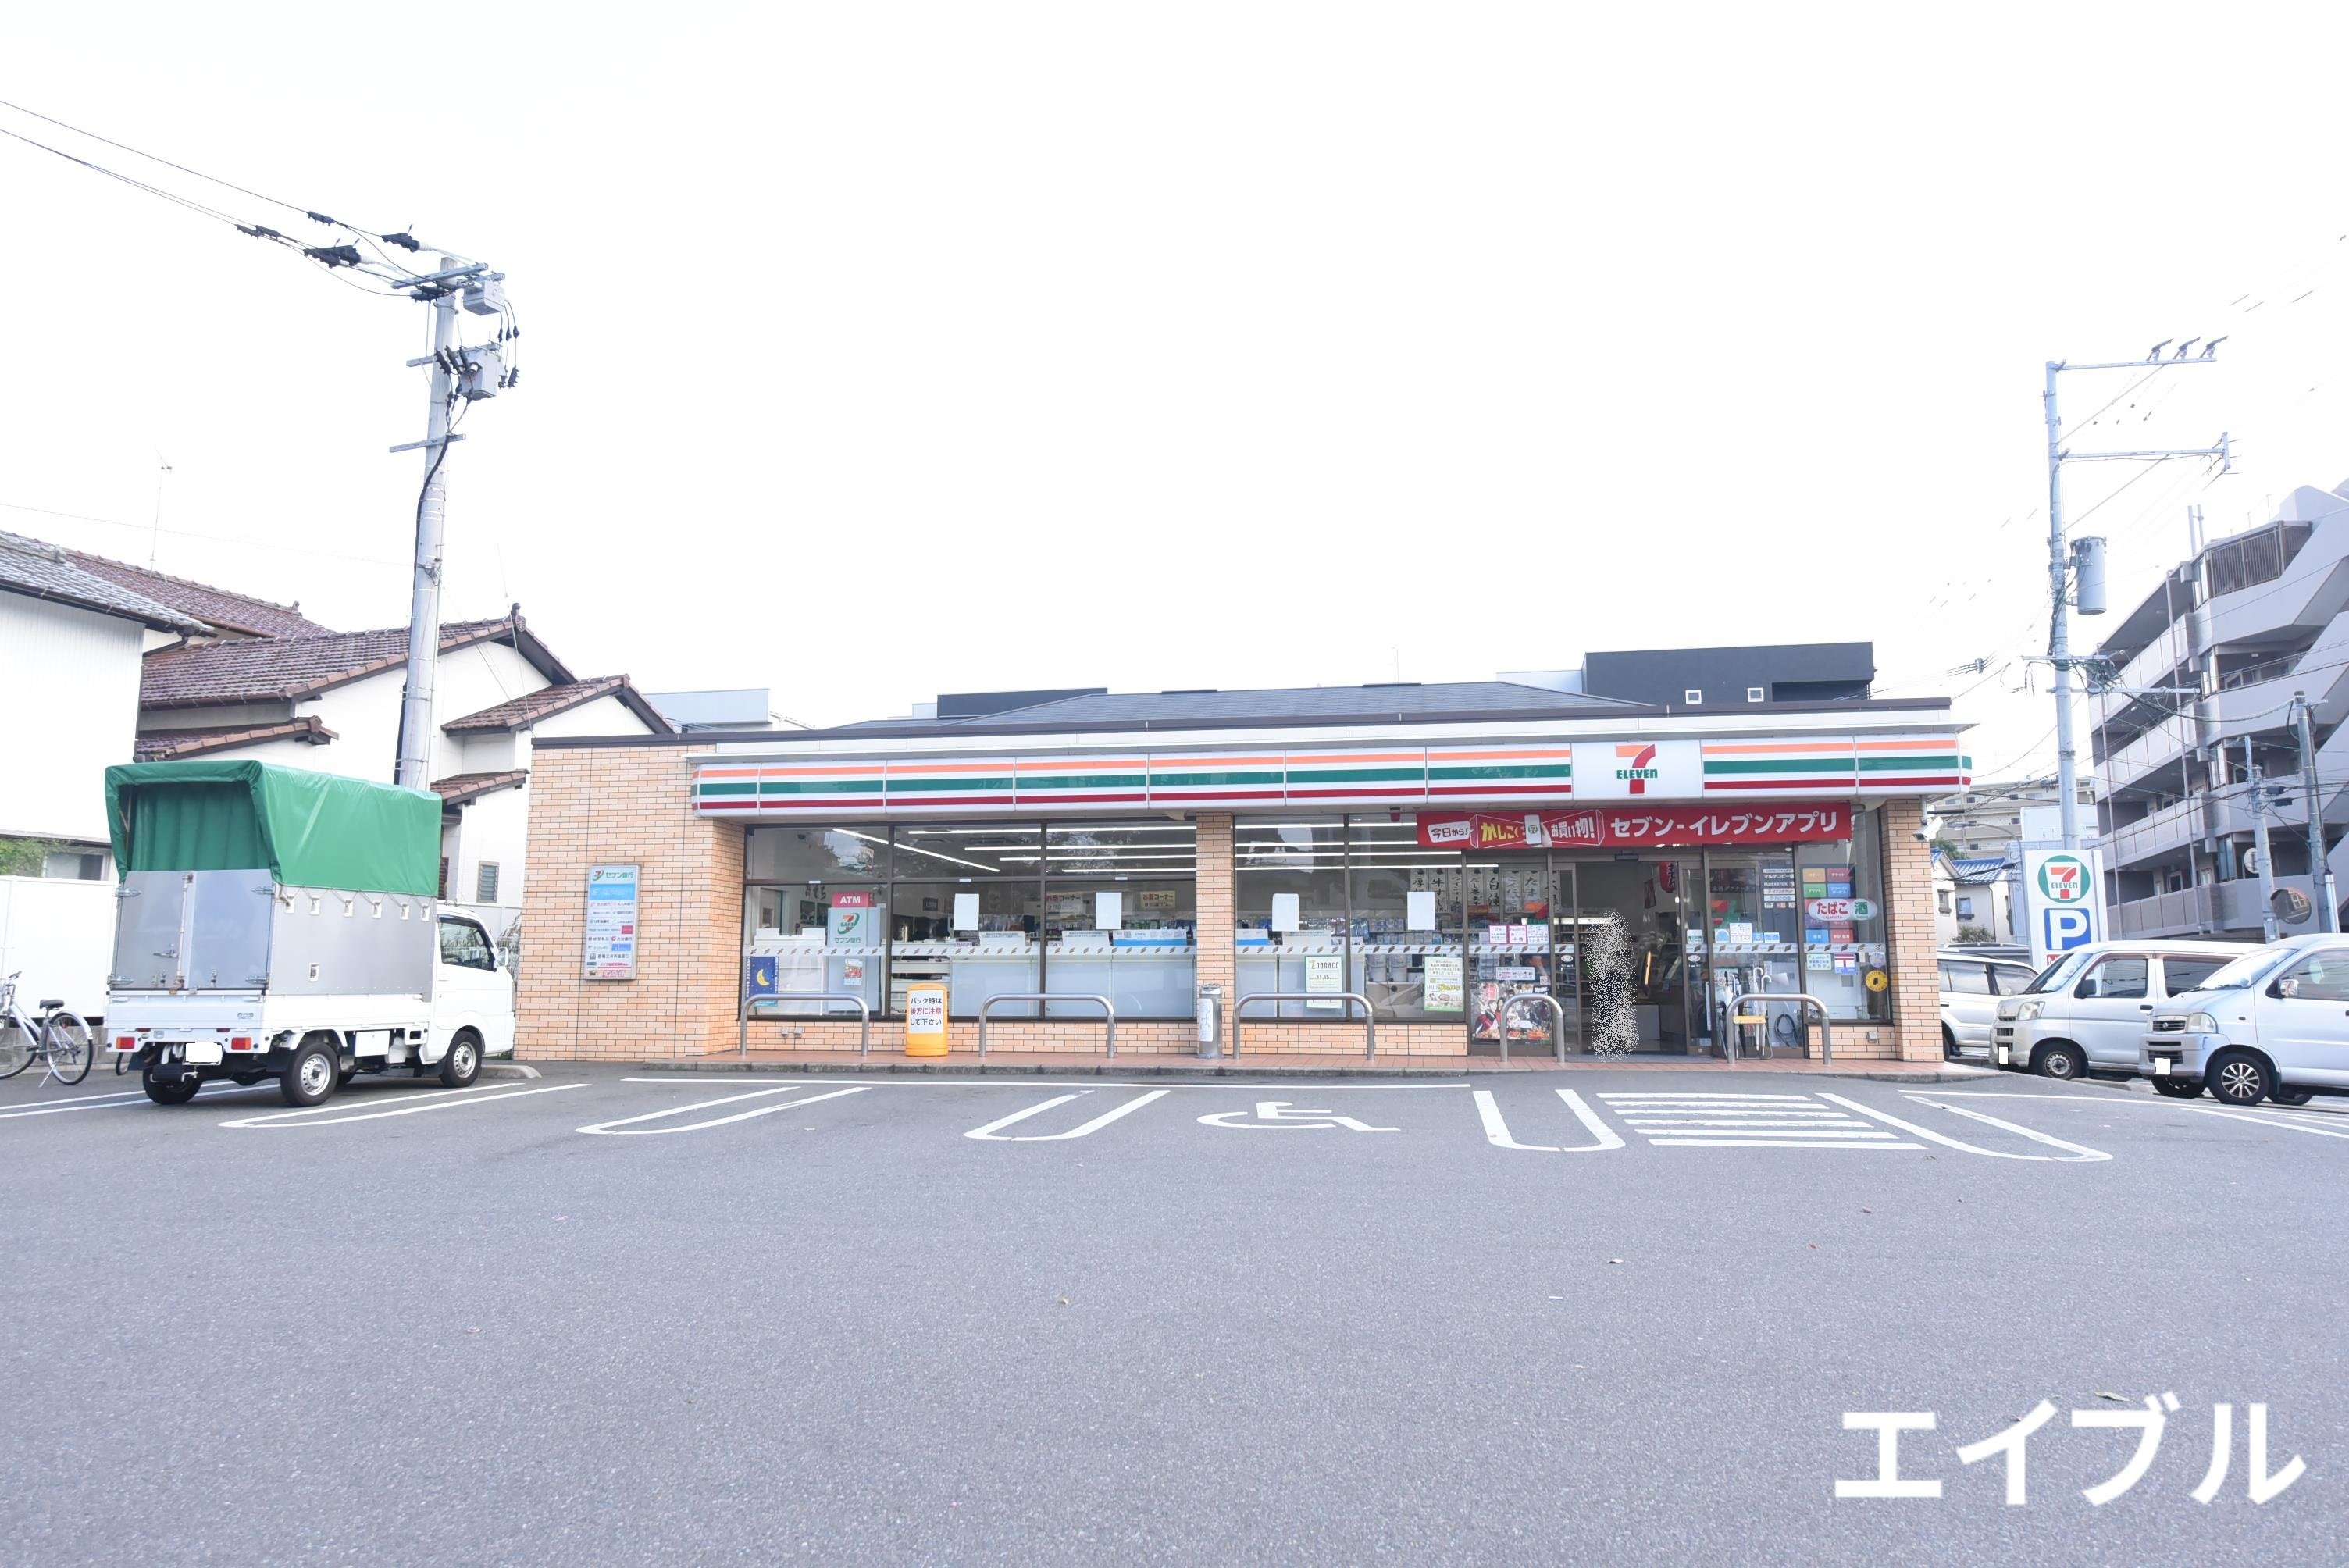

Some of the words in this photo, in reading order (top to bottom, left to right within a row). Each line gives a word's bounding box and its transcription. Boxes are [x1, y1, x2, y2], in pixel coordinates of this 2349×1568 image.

[1431, 827, 1468, 838] 今日から!
[1481, 822, 1519, 841] かしこく
[1551, 817, 1595, 839] お買い物!
[840, 896, 861, 904] ATM
[1816, 901, 1848, 914] たばこ
[1854, 901, 1869, 914] 酒
[2049, 910, 2087, 950] P
